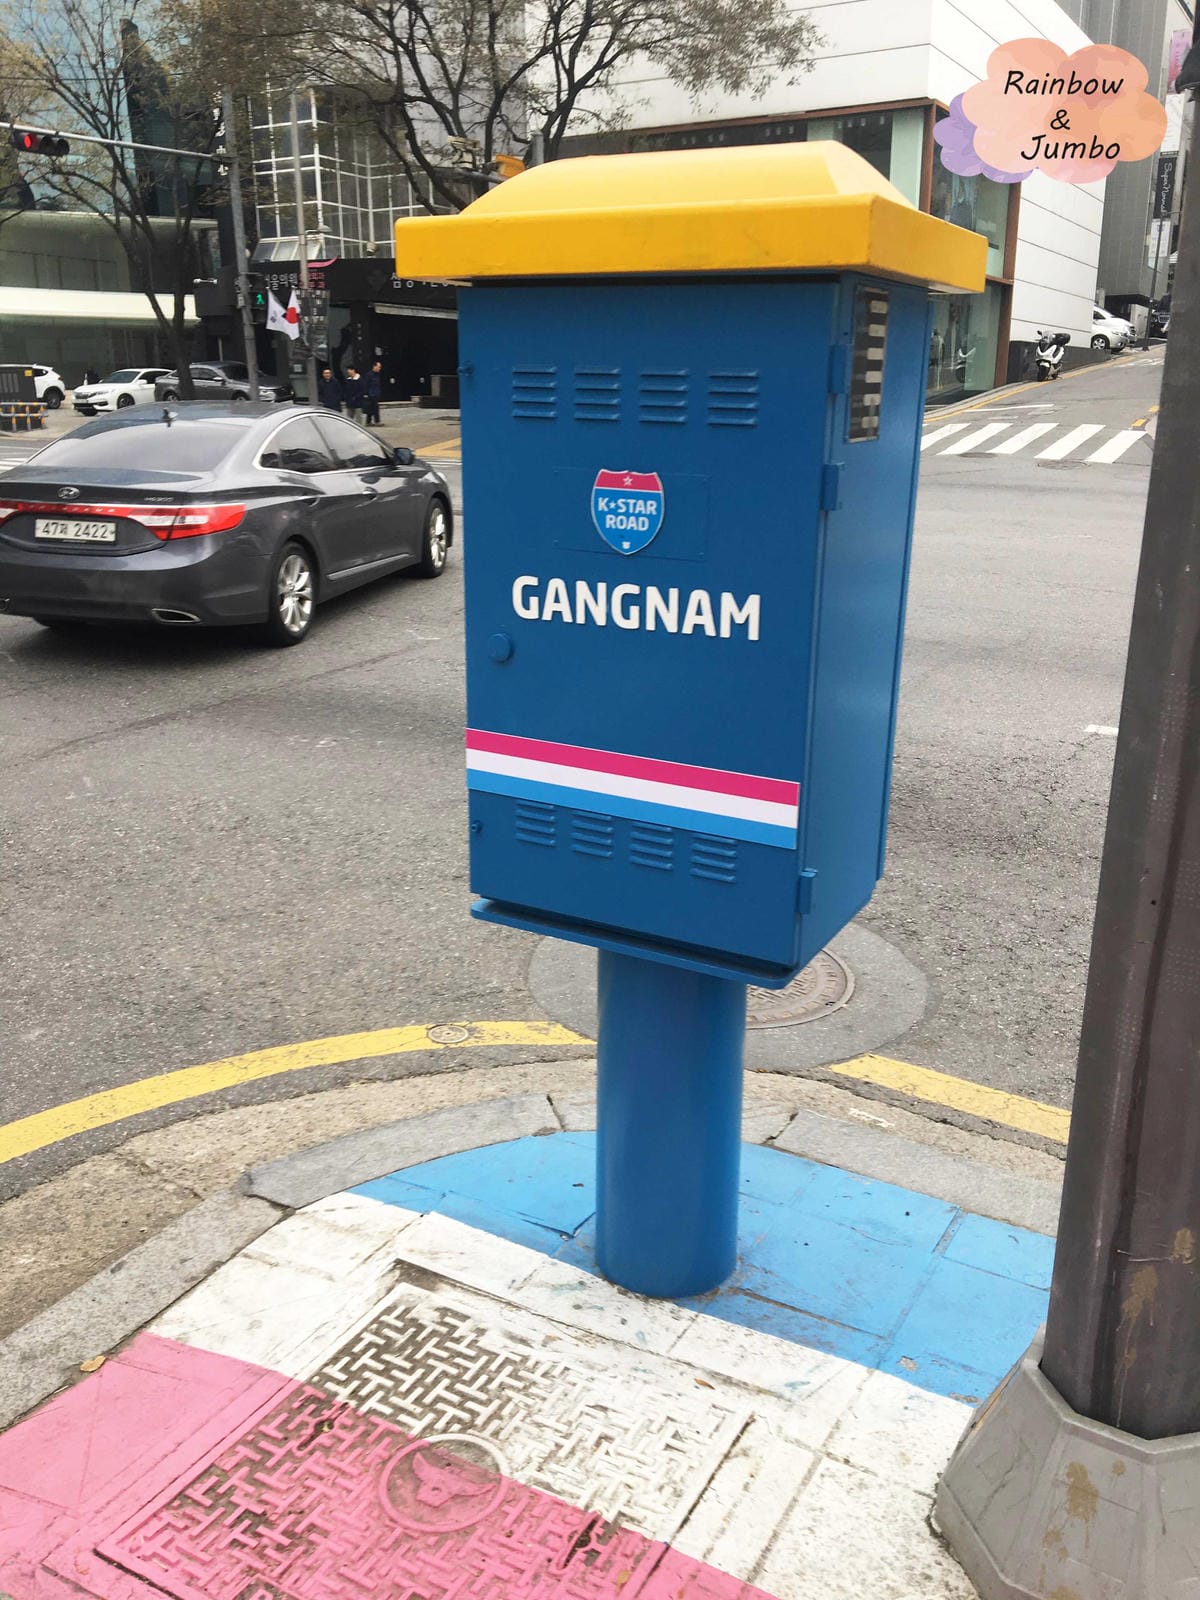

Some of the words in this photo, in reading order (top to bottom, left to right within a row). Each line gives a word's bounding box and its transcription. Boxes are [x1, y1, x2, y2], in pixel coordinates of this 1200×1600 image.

[73, 523, 108, 538] 2422
[605, 514, 649, 531] ROAD
[512, 575, 761, 641] GANGNAM
